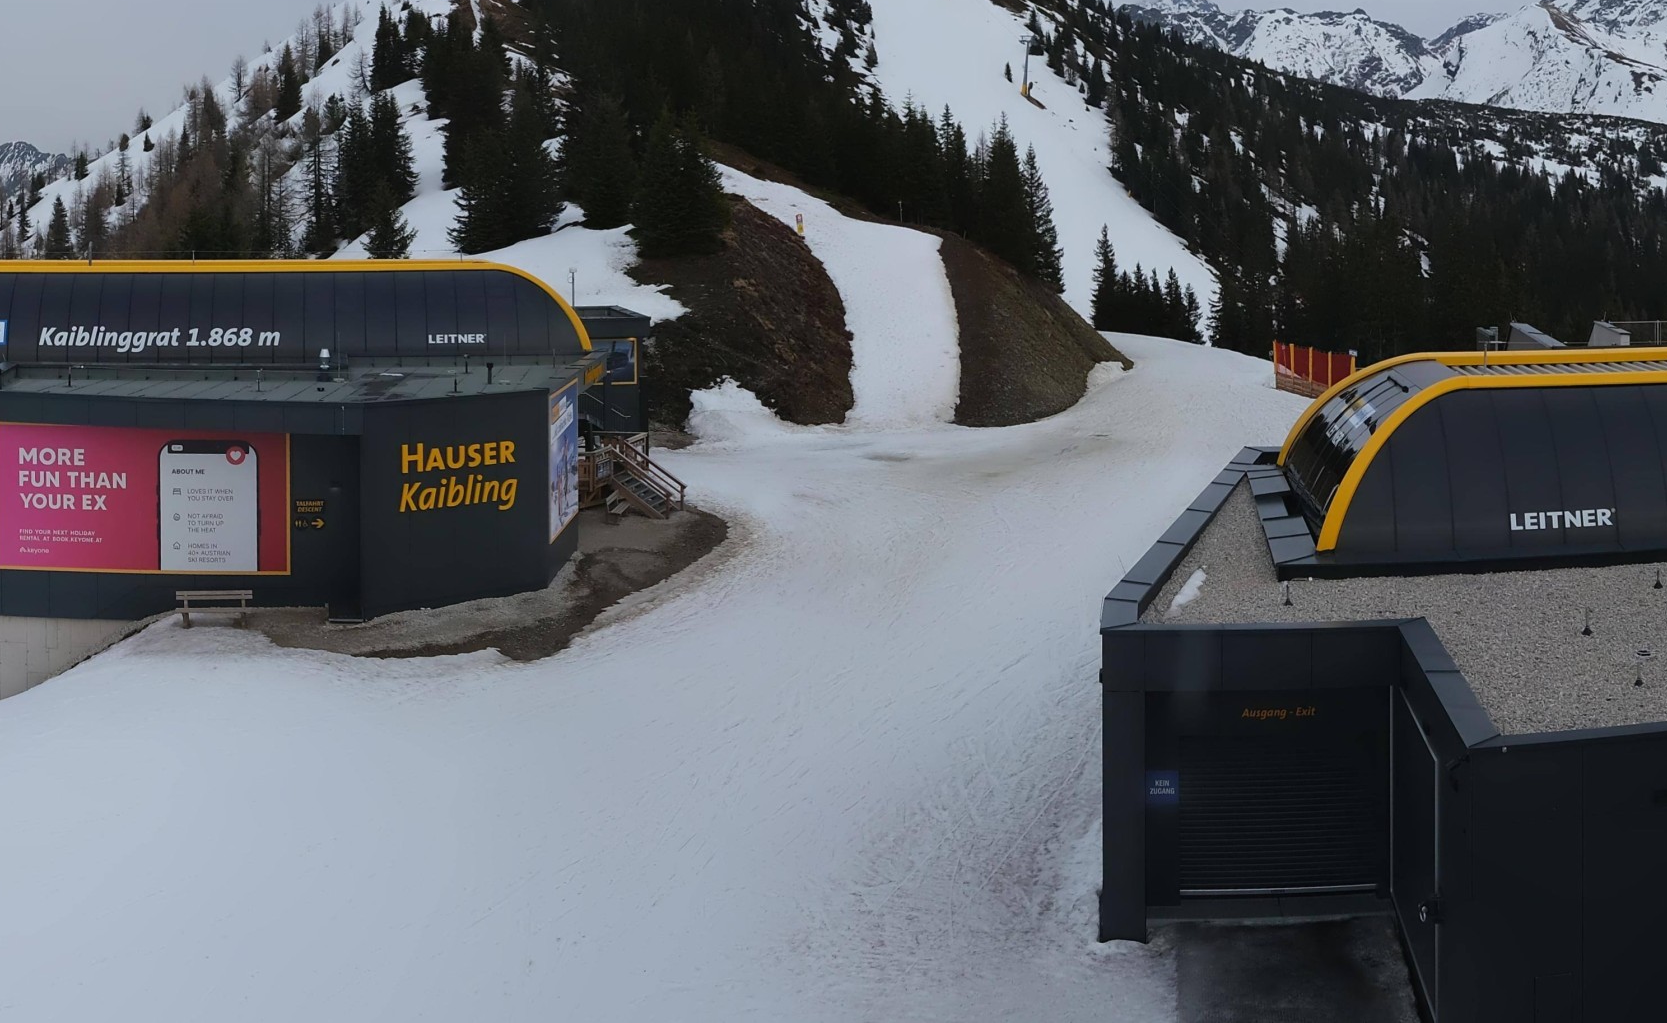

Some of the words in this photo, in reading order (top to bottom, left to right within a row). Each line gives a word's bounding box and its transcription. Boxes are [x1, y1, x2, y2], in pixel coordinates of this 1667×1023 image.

[38, 326, 181, 352] Kaiblinggrat
[186, 328, 253, 347] 1.868
[258, 331, 280, 346] m
[428, 333, 486, 344] LEITNER
[19, 447, 85, 466] MORE
[401, 440, 516, 474] HAUSER
[19, 470, 60, 488] FUN
[67, 471, 127, 489] THAN
[20, 493, 75, 510] YOUR
[82, 495, 107, 511] EX
[400, 474, 518, 513] Kaibling
[1509, 508, 1614, 531] LEITNER
[1242, 708, 1287, 720] Ausgang
[1296, 706, 1315, 716] Exit
[1150, 787, 1175, 795] ZUGANG
[1154, 779, 1170, 787] KEIN
